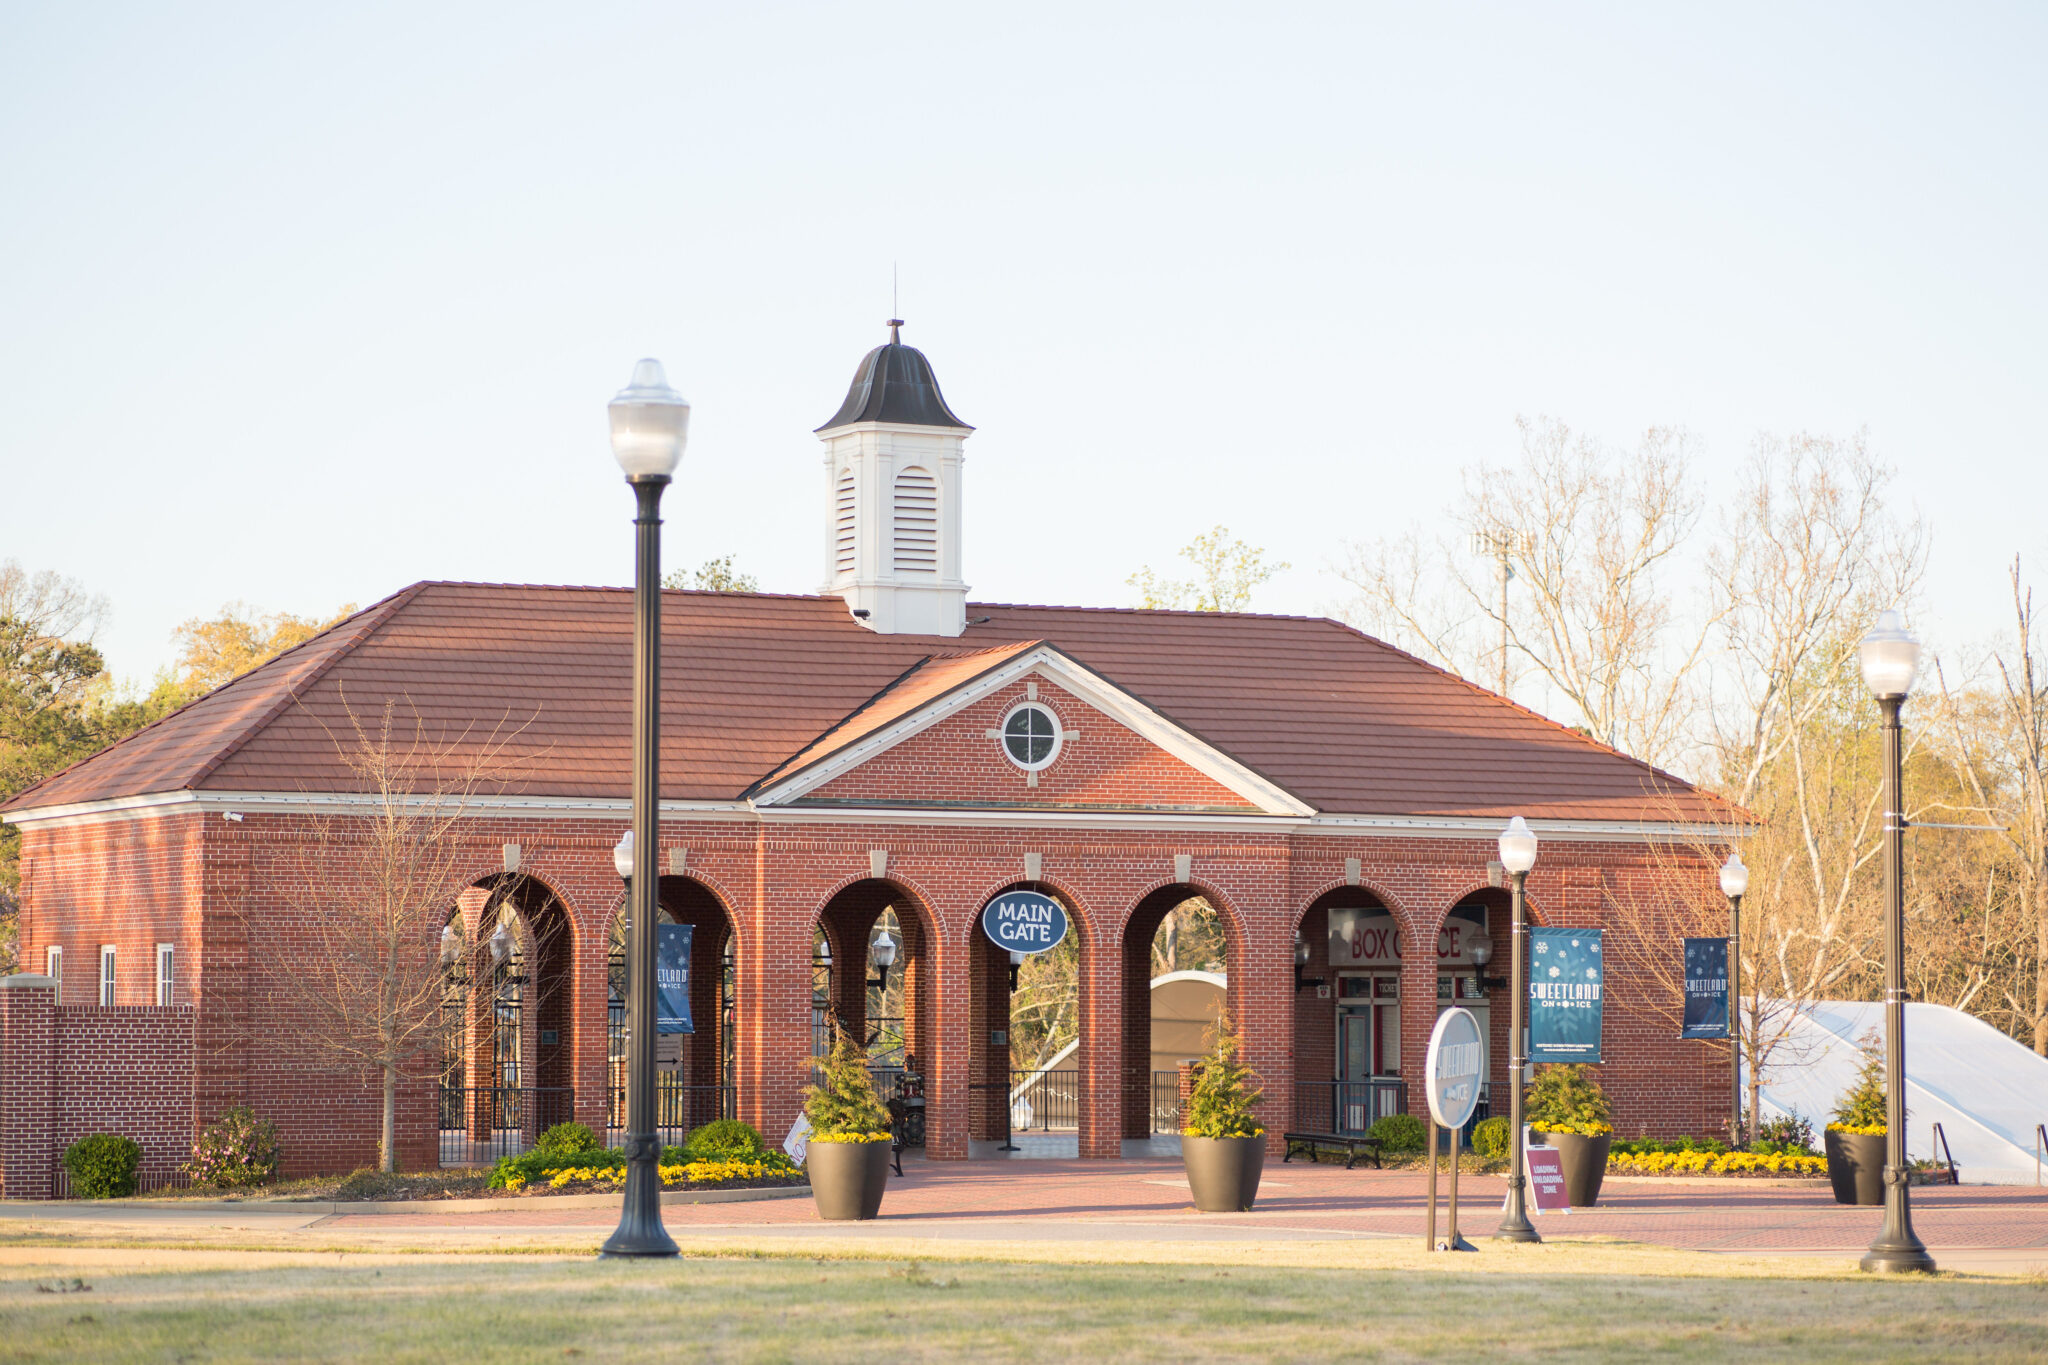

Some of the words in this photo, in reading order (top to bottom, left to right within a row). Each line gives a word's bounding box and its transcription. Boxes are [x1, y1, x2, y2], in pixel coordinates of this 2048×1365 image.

[998, 902, 1053, 923] MAIN
[1000, 922, 1051, 942] GATE
[1352, 928, 1389, 959] BOX
[1394, 927, 1461, 959] OCE
[657, 968, 687, 983] ETLAND
[1529, 982, 1599, 1000] SWEETLAND
[1685, 979, 1726, 991] SWEETLAND
[1541, 1000, 1555, 1008] ON
[1576, 1001, 1592, 1009] ICE
[1532, 1174, 1564, 1184] UNLOADING
[1542, 1185, 1558, 1194] ZONE
